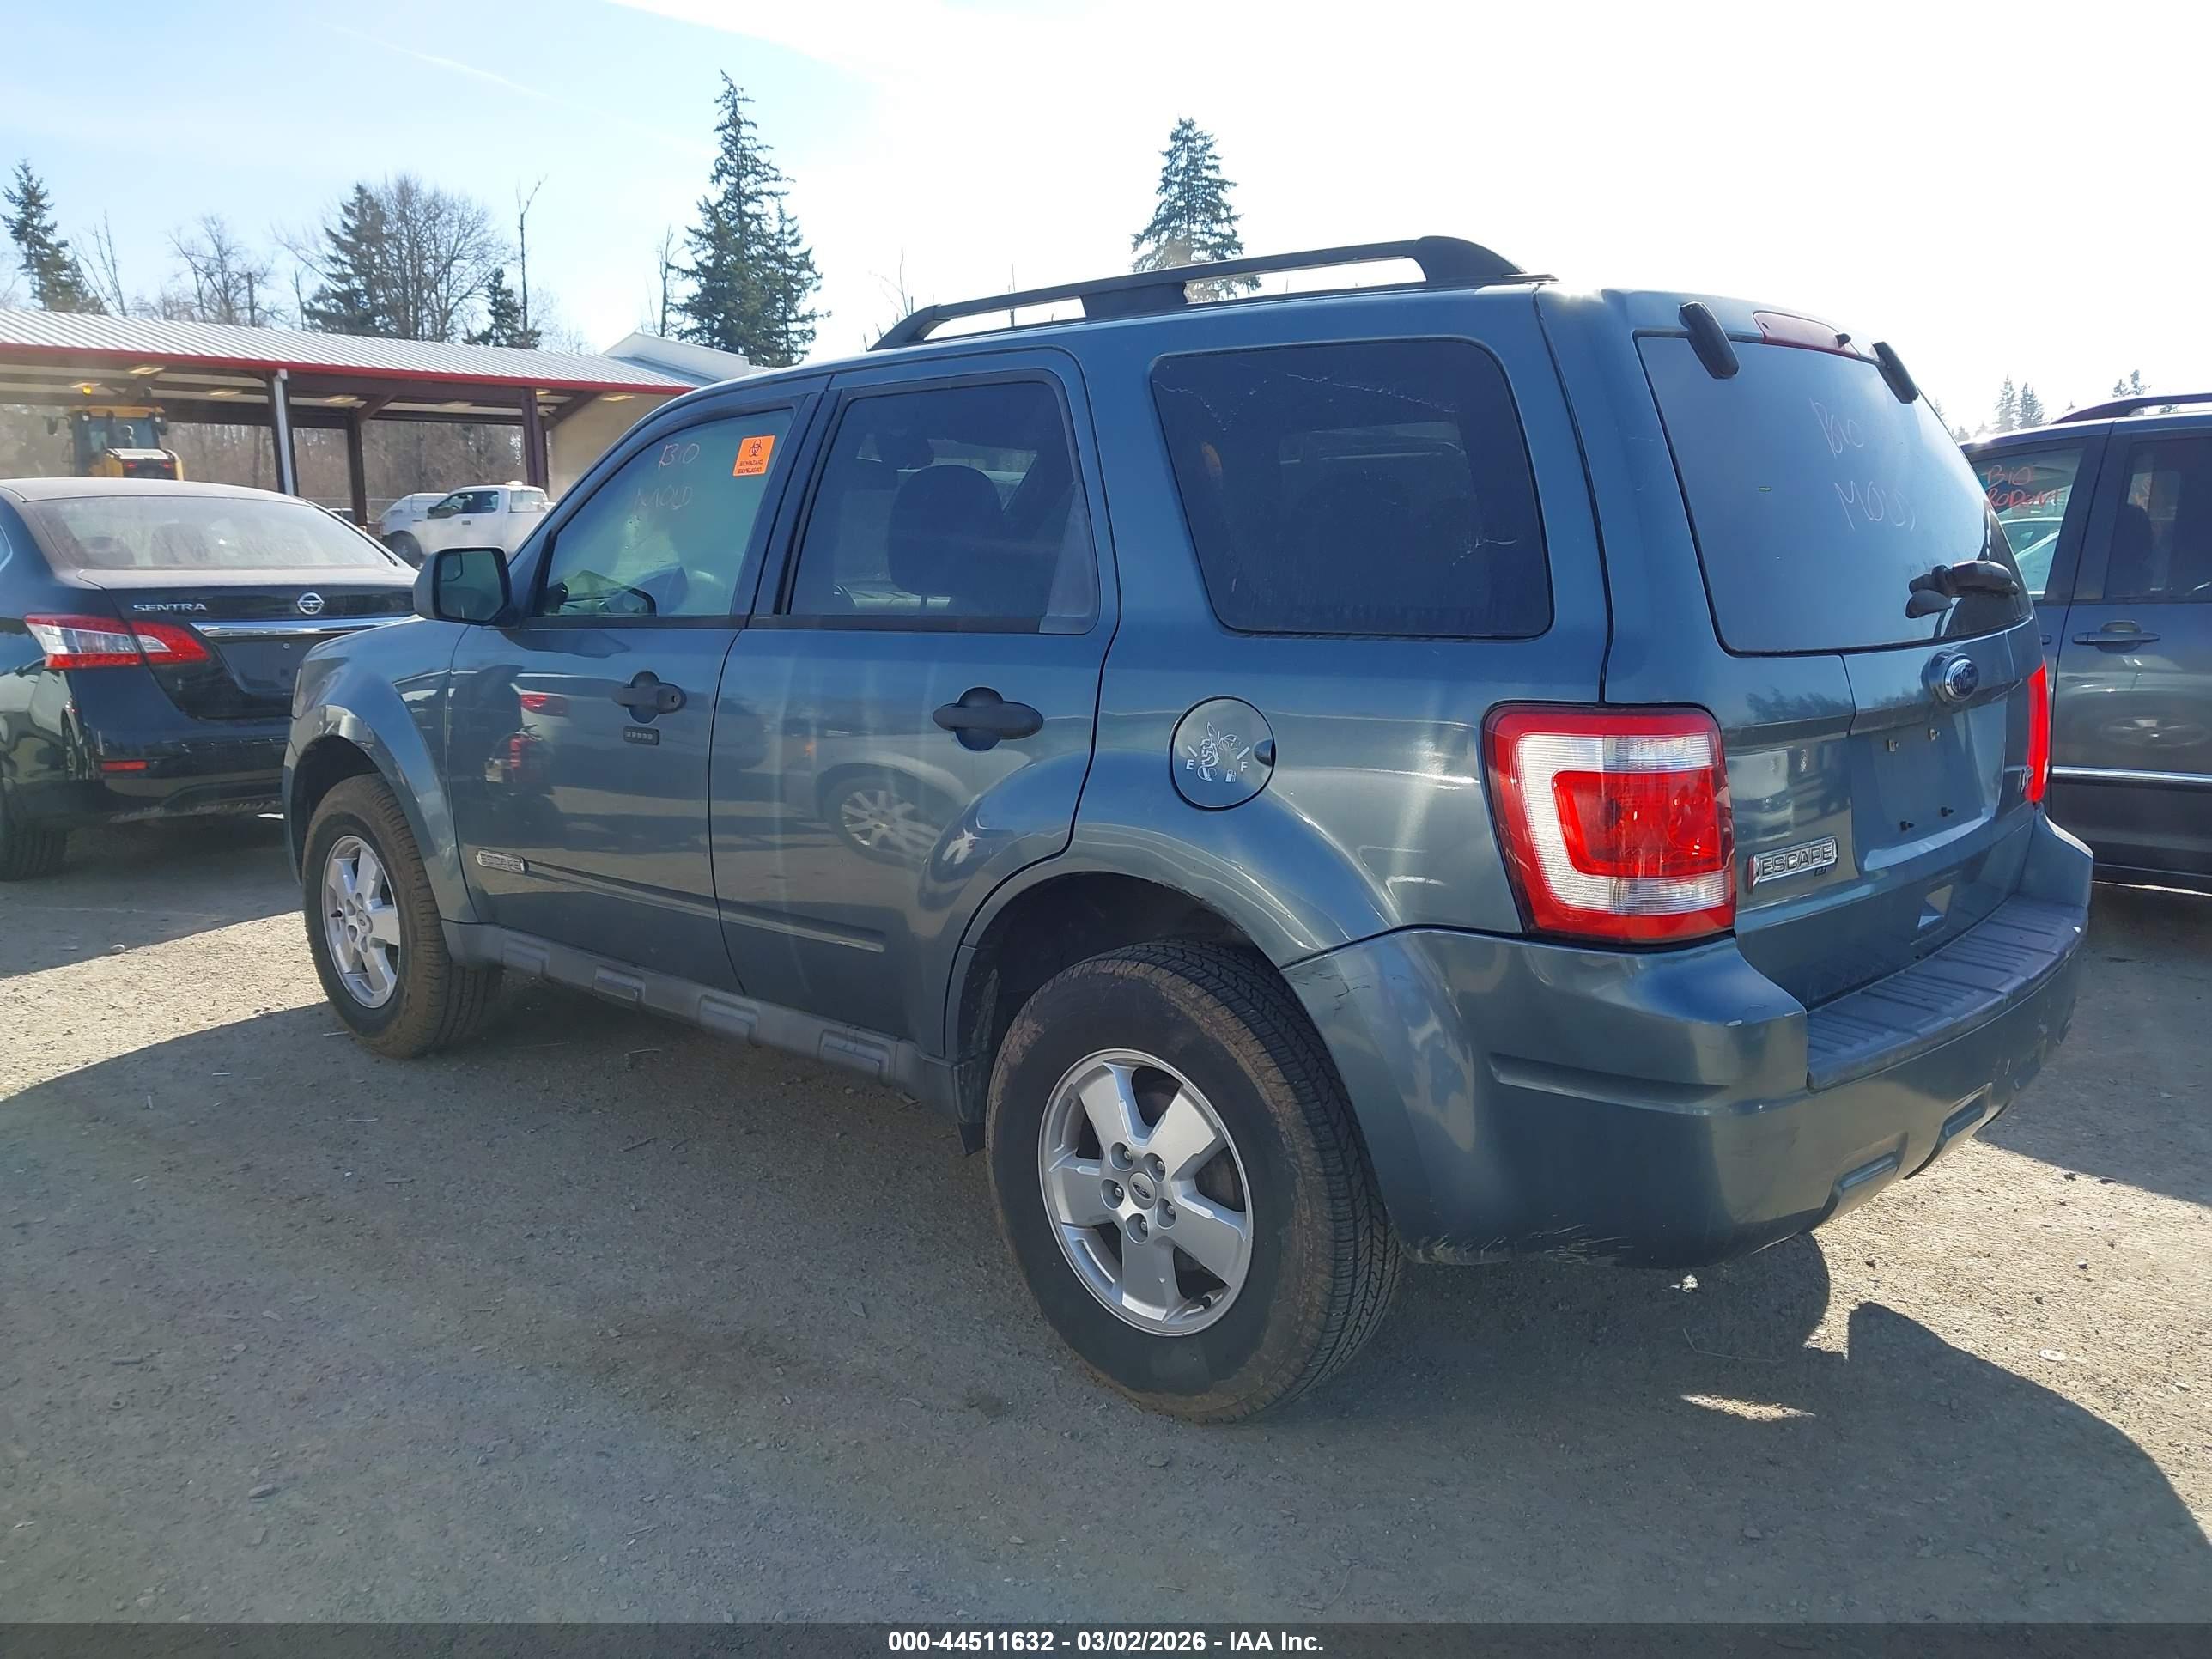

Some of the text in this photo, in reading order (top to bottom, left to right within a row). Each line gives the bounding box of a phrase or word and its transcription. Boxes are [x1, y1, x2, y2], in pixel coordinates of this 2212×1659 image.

[132, 603, 207, 611] SENTRA
[1186, 759, 1194, 770] E
[1240, 761, 1249, 773] F
[1761, 843, 1832, 877] ESCAPE
